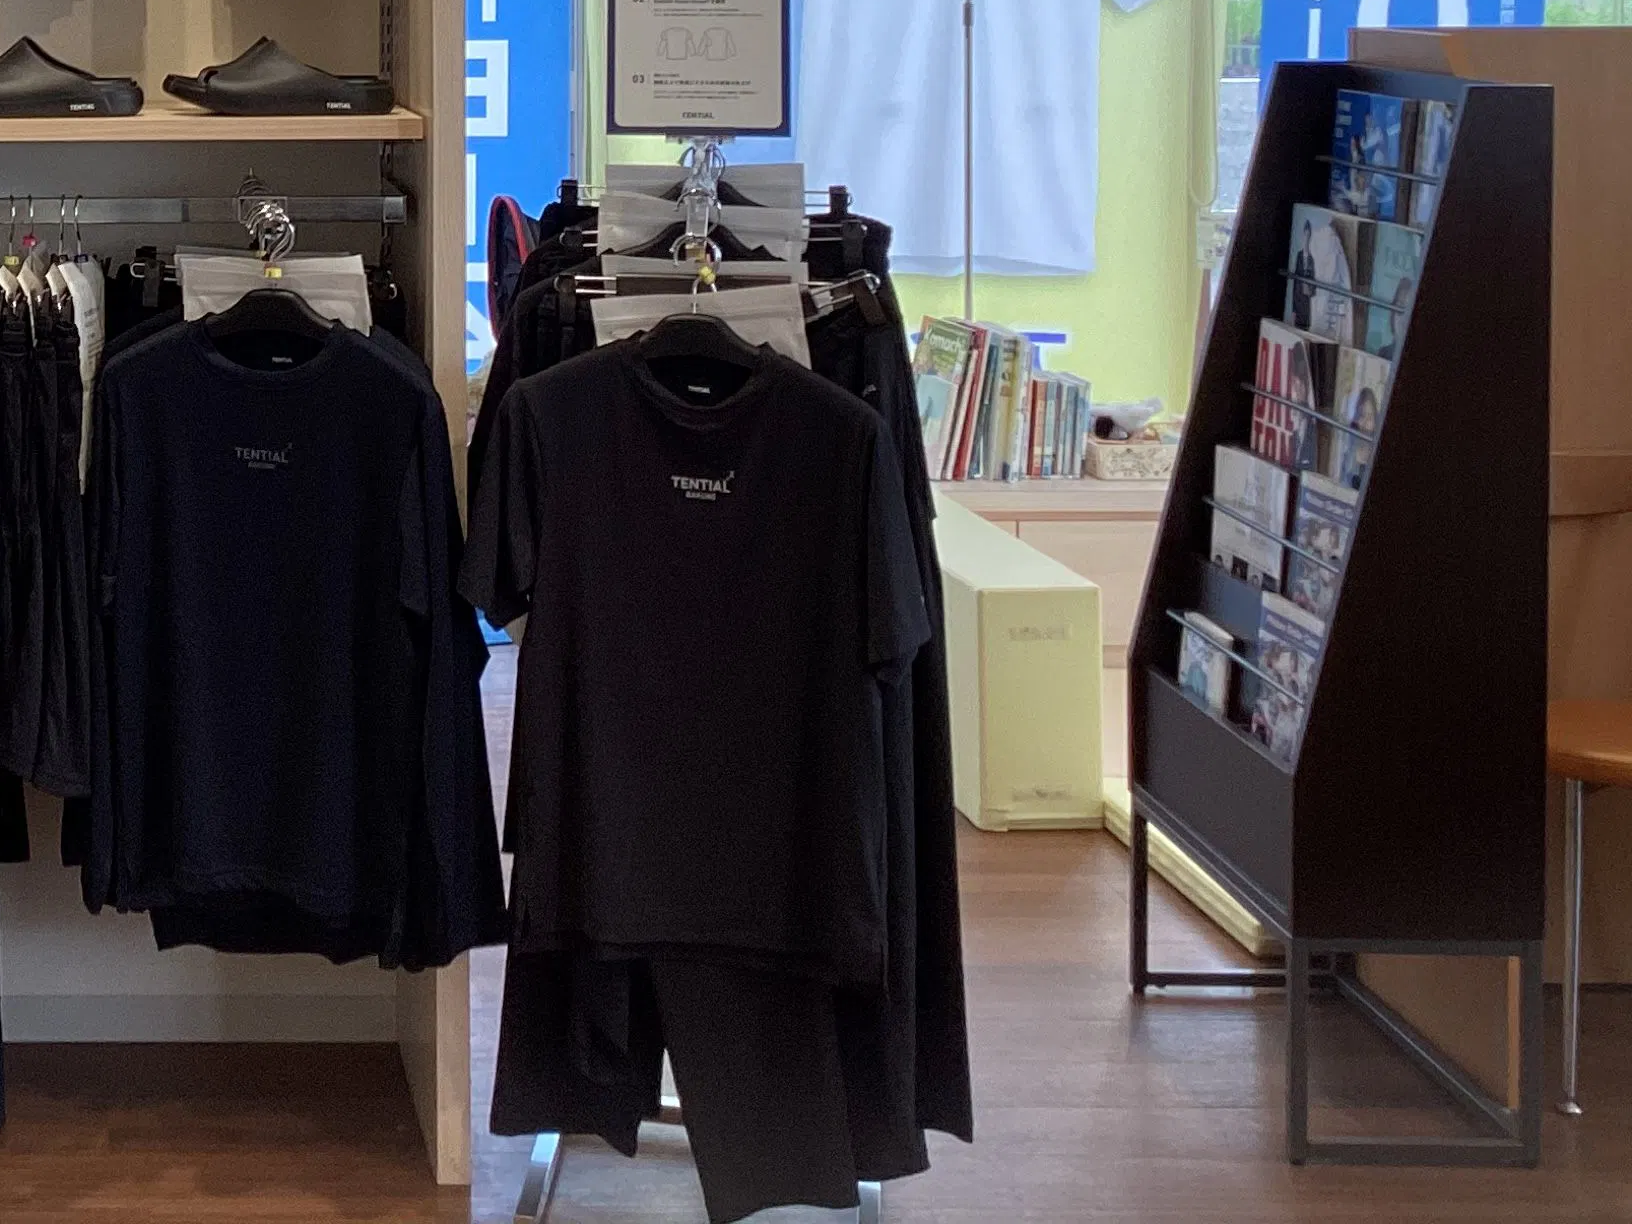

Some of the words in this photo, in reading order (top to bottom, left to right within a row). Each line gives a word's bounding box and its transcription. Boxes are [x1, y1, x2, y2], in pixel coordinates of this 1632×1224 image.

[632, 74, 645, 84] 03
[235, 447, 289, 464] TENTIAL
[671, 475, 732, 494] TENTIAL
